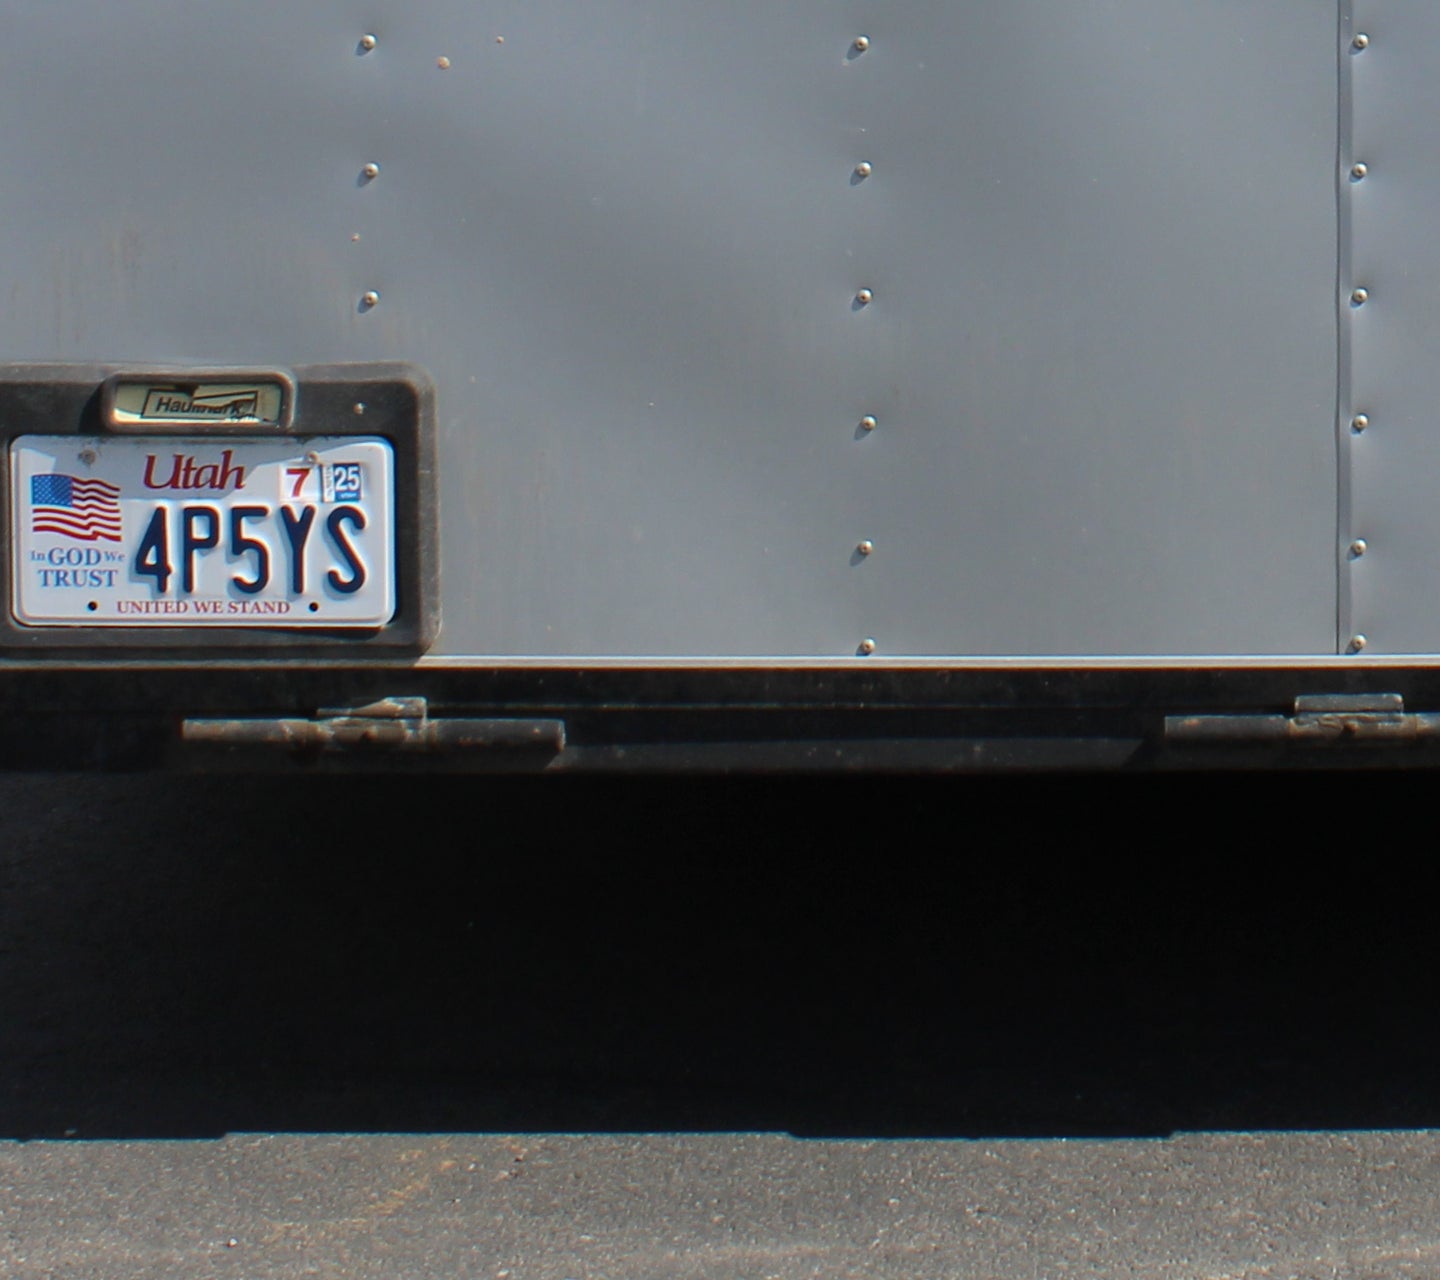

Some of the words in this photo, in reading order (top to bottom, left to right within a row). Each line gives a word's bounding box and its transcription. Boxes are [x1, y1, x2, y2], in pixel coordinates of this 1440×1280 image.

[142, 449, 247, 490] Utah
[286, 467, 311, 497] 7
[334, 465, 360, 492] 25
[30, 550, 45, 562] In
[47, 546, 102, 567] GOD
[103, 551, 126, 562] We
[135, 504, 368, 594] 4P5YS
[38, 569, 118, 588] TRUST
[116, 600, 189, 615] UNITED
[193, 600, 224, 614] WE
[227, 600, 291, 615] STAND
